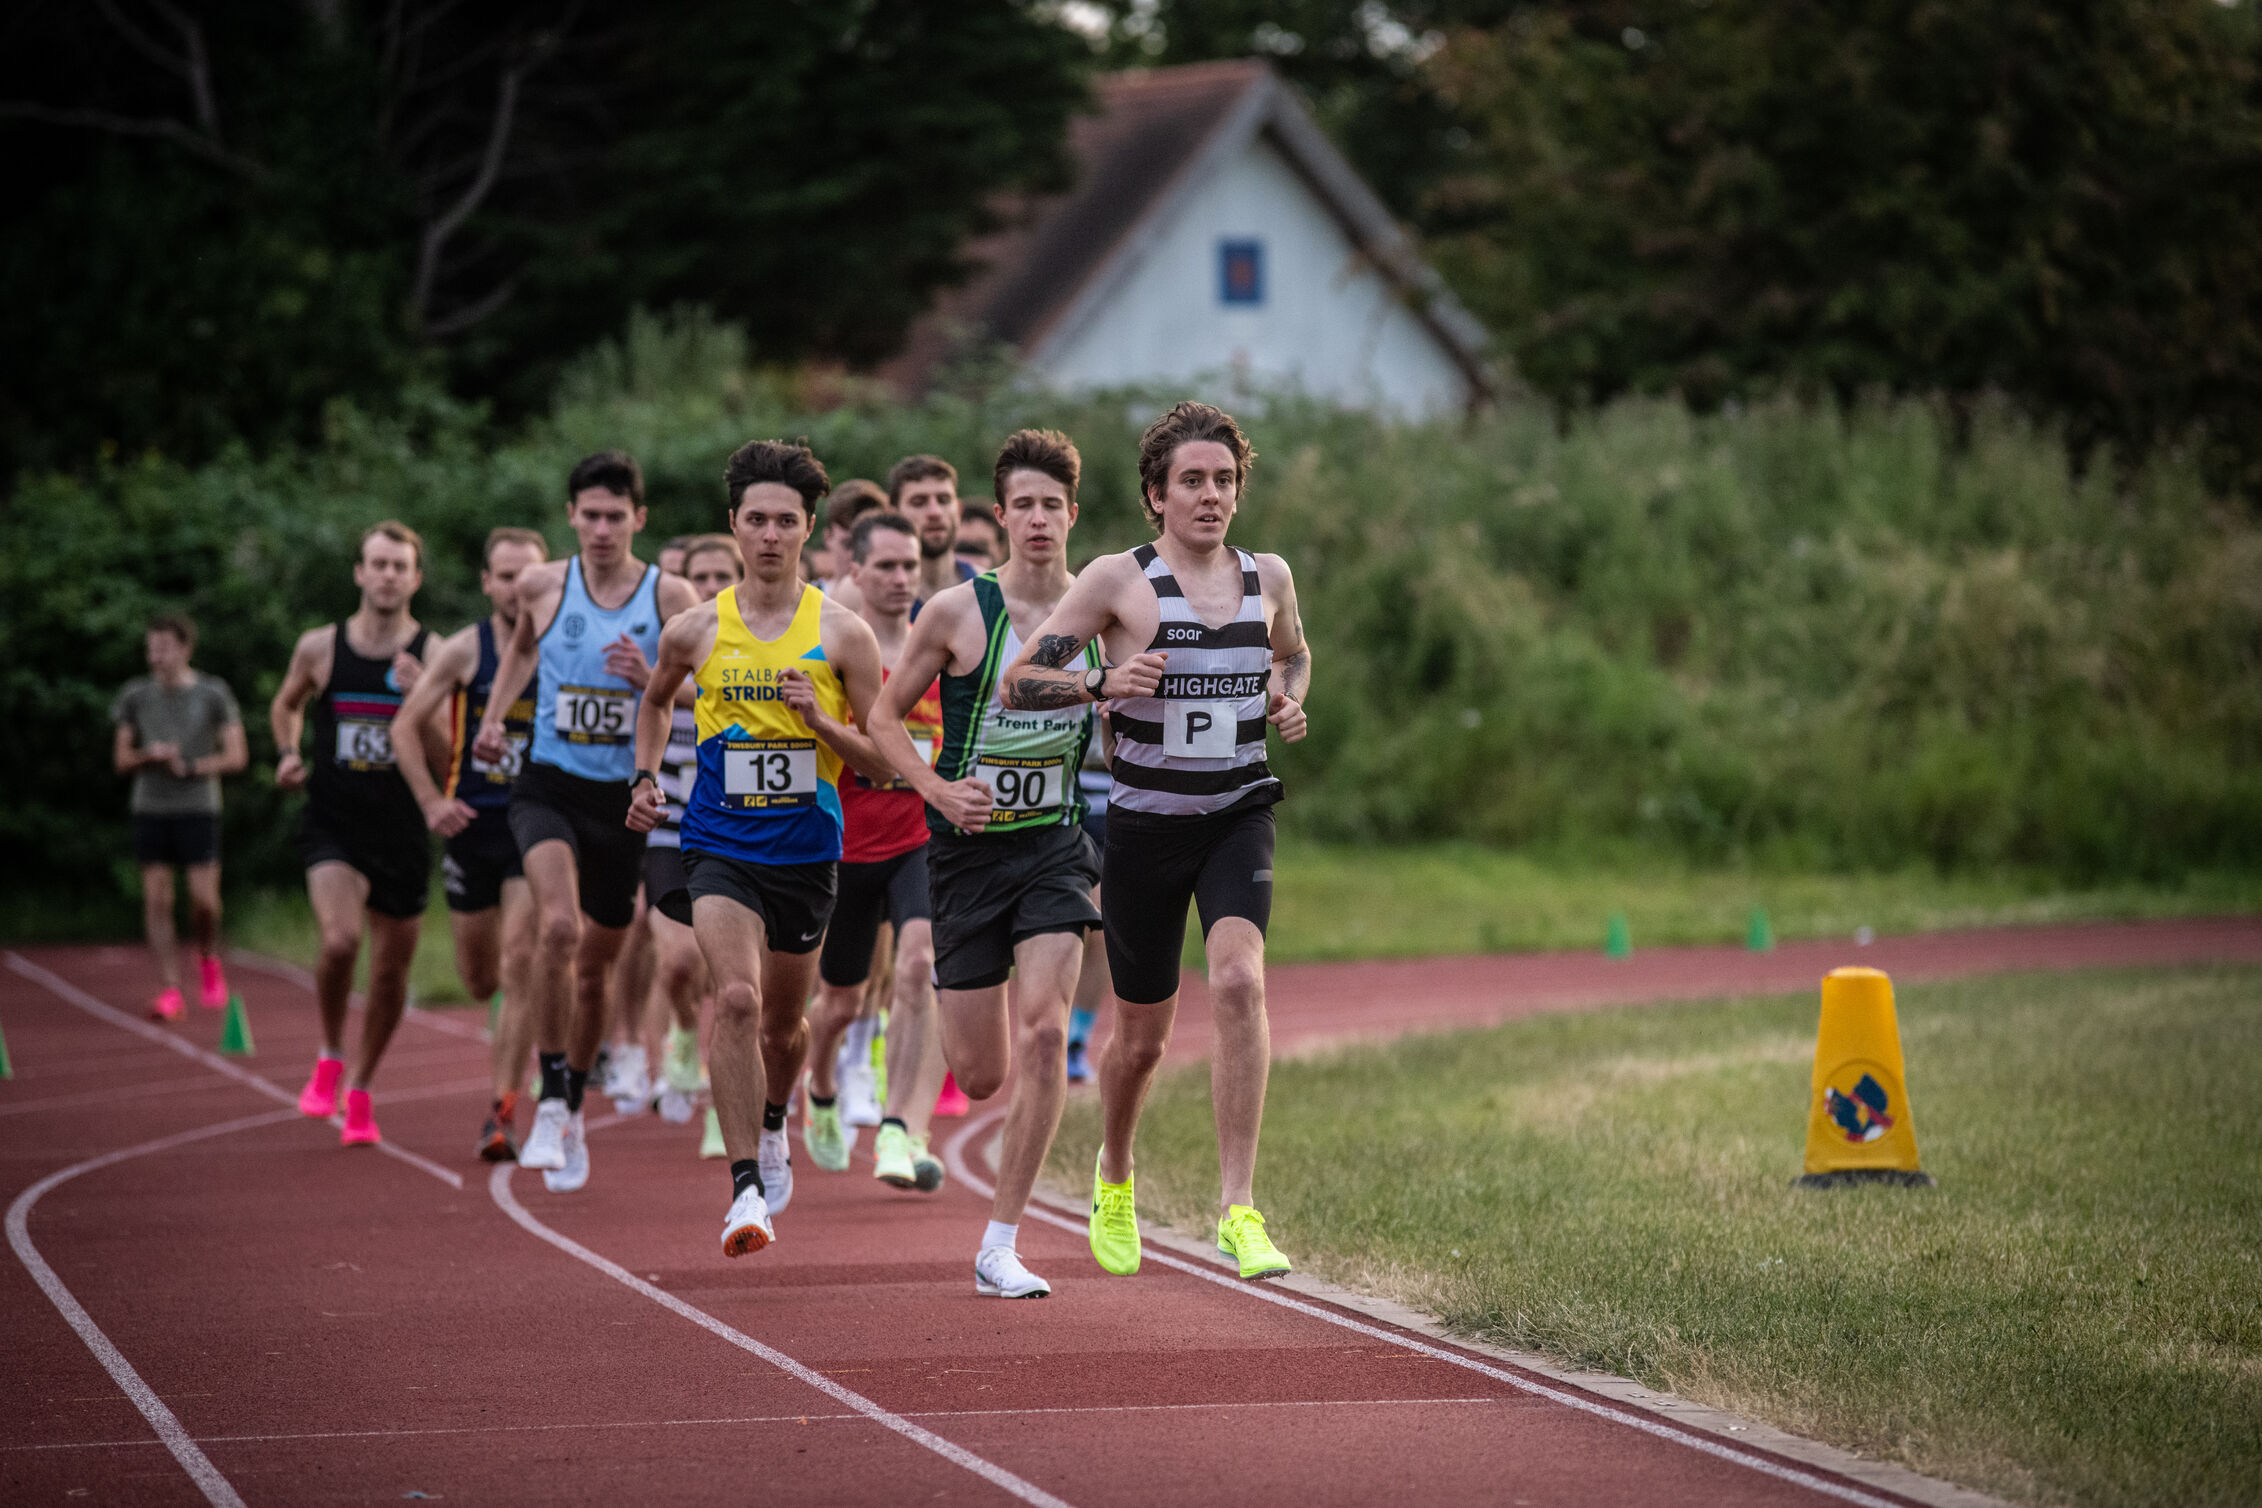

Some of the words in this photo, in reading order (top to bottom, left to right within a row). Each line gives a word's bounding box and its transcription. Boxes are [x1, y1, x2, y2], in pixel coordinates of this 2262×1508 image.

[1167, 629, 1202, 640] soar
[722, 669, 739, 683] ST
[1164, 677, 1260, 696] HIGHGATE
[567, 698, 623, 733] 105
[996, 716, 1038, 730] Trent
[1044, 719, 1077, 731] Park
[1186, 711, 1212, 744] P
[353, 727, 392, 761] 63
[727, 742, 766, 750] FINSBURY
[767, 742, 788, 750] PARK
[981, 757, 1020, 767] FINSBURY
[749, 753, 792, 793] 13
[995, 769, 1046, 808] 90
